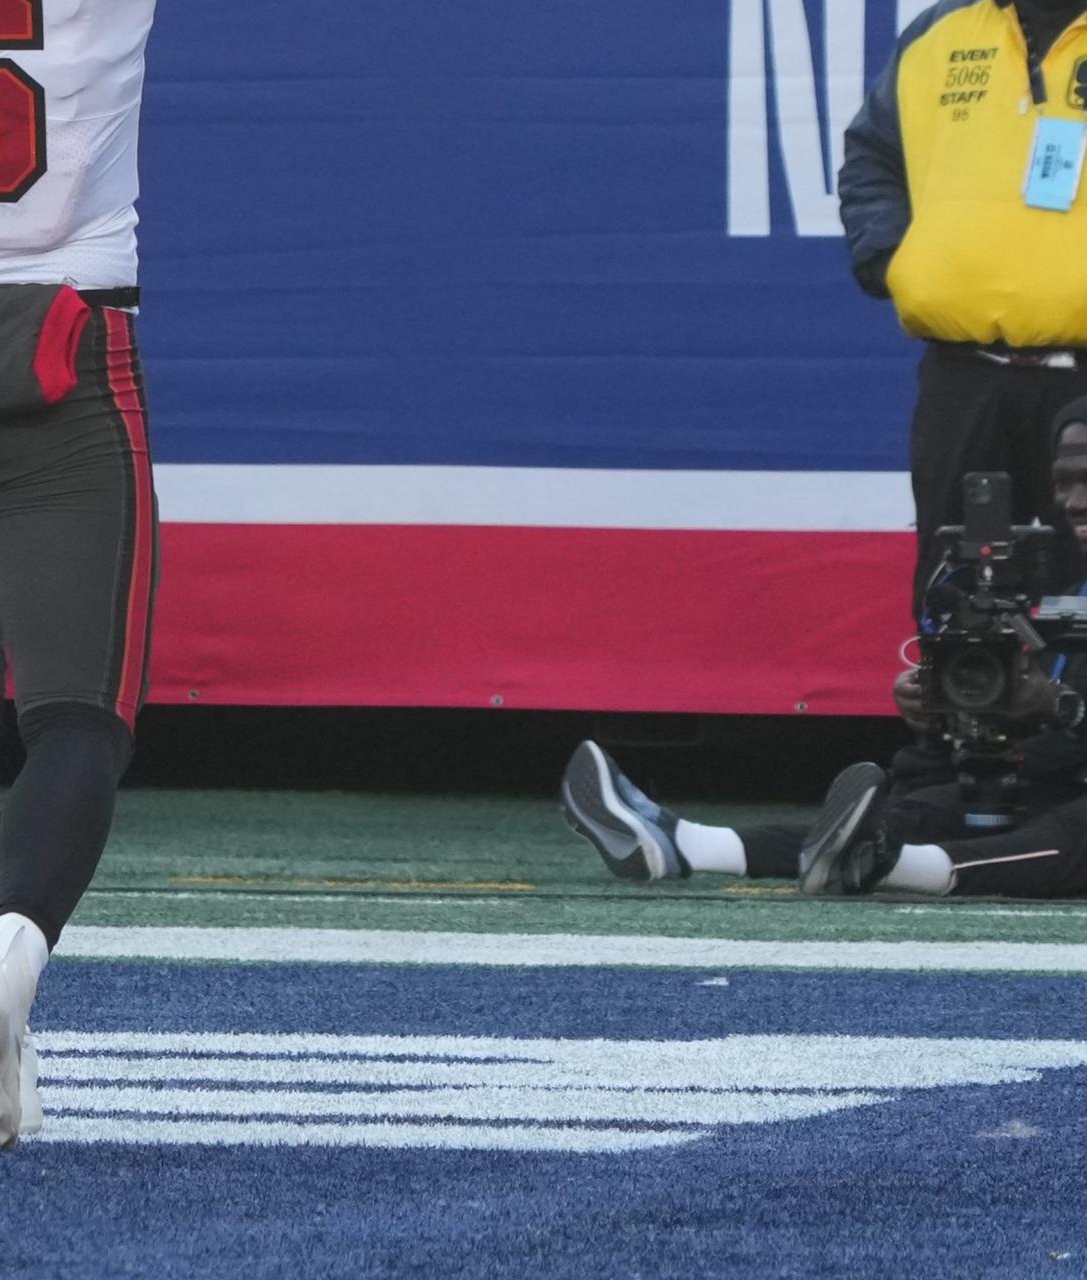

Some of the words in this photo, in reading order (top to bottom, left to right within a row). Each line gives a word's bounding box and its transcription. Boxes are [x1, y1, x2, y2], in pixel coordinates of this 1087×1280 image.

[949, 48, 999, 63] EVENT
[945, 65, 992, 88] 5066
[939, 89, 988, 106] STAFF
